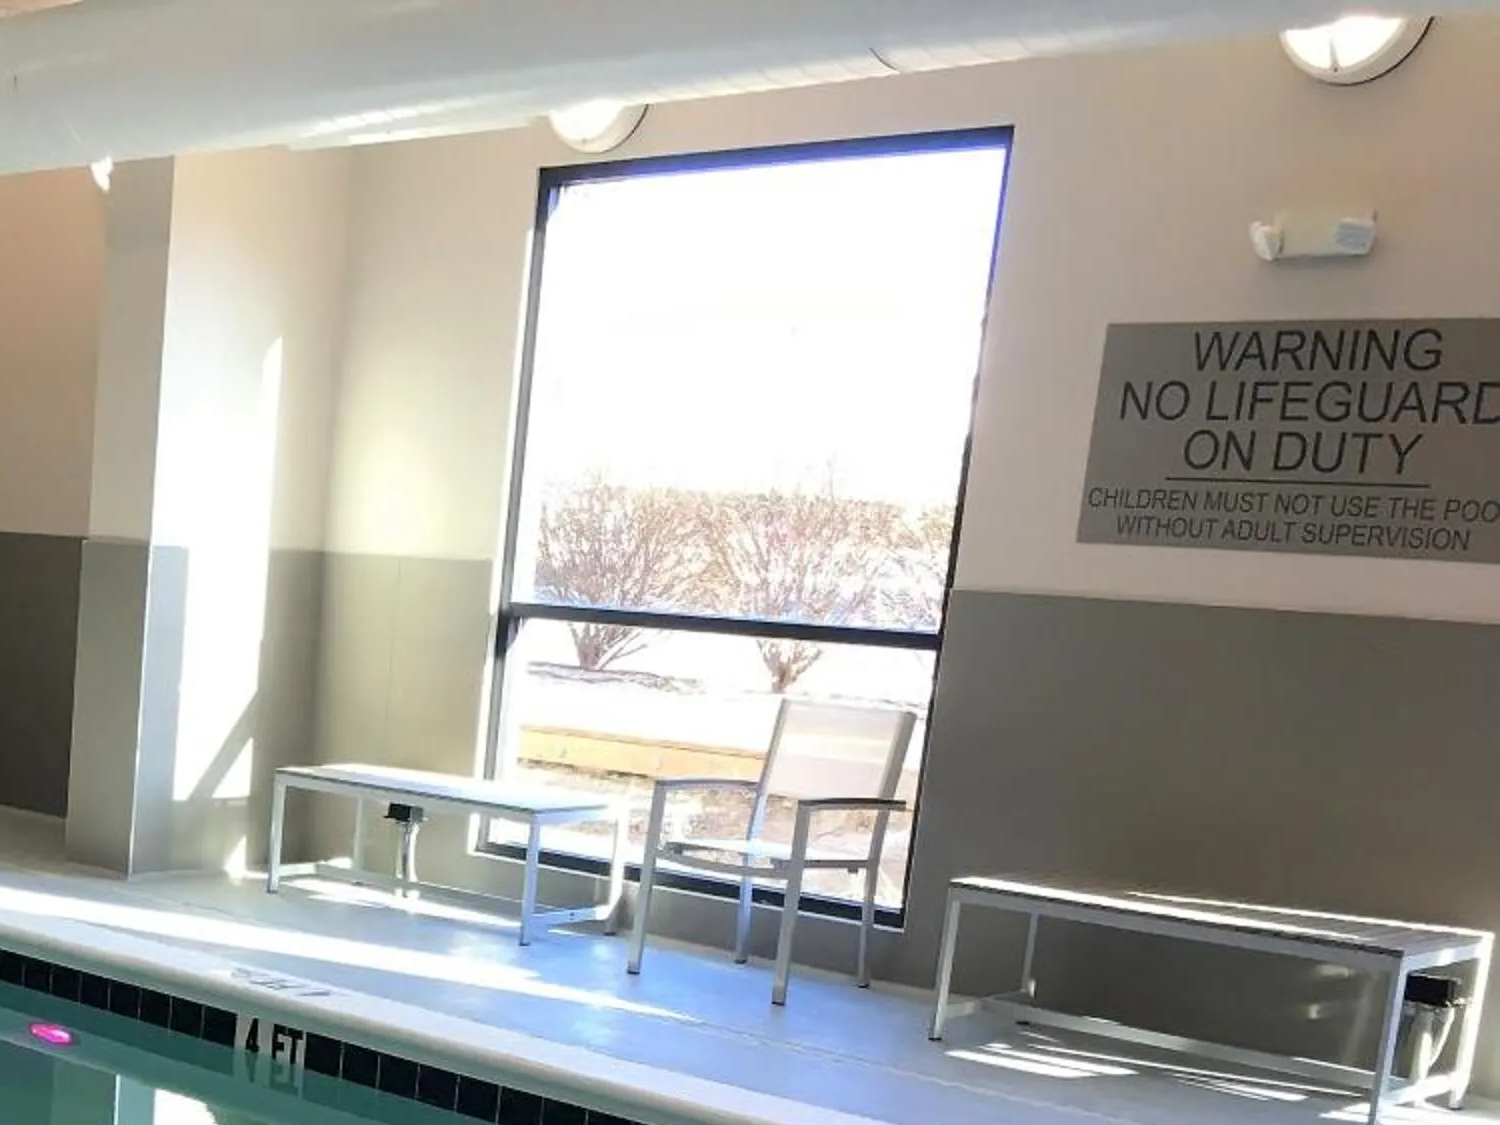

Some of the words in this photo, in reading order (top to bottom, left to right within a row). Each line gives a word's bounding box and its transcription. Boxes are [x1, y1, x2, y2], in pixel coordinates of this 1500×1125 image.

[1194, 329, 1443, 372] WARNING
[1120, 380, 1191, 421] NO
[1205, 380, 1500, 425] LIFEGUARD
[1183, 429, 1256, 471] ON
[1273, 431, 1424, 475] DUTY
[1088, 487, 1199, 511] CHILDREN
[1202, 491, 1270, 513] MUST
[1274, 493, 1325, 516] NOT
[1330, 495, 1381, 518] USE
[1388, 497, 1437, 521] THE
[1116, 513, 1220, 539] WITHOUT
[1221, 518, 1298, 544] ADULT
[1300, 522, 1472, 551] SUPERVISION
[245, 1017, 260, 1053] 4
[271, 1023, 304, 1065] FT
